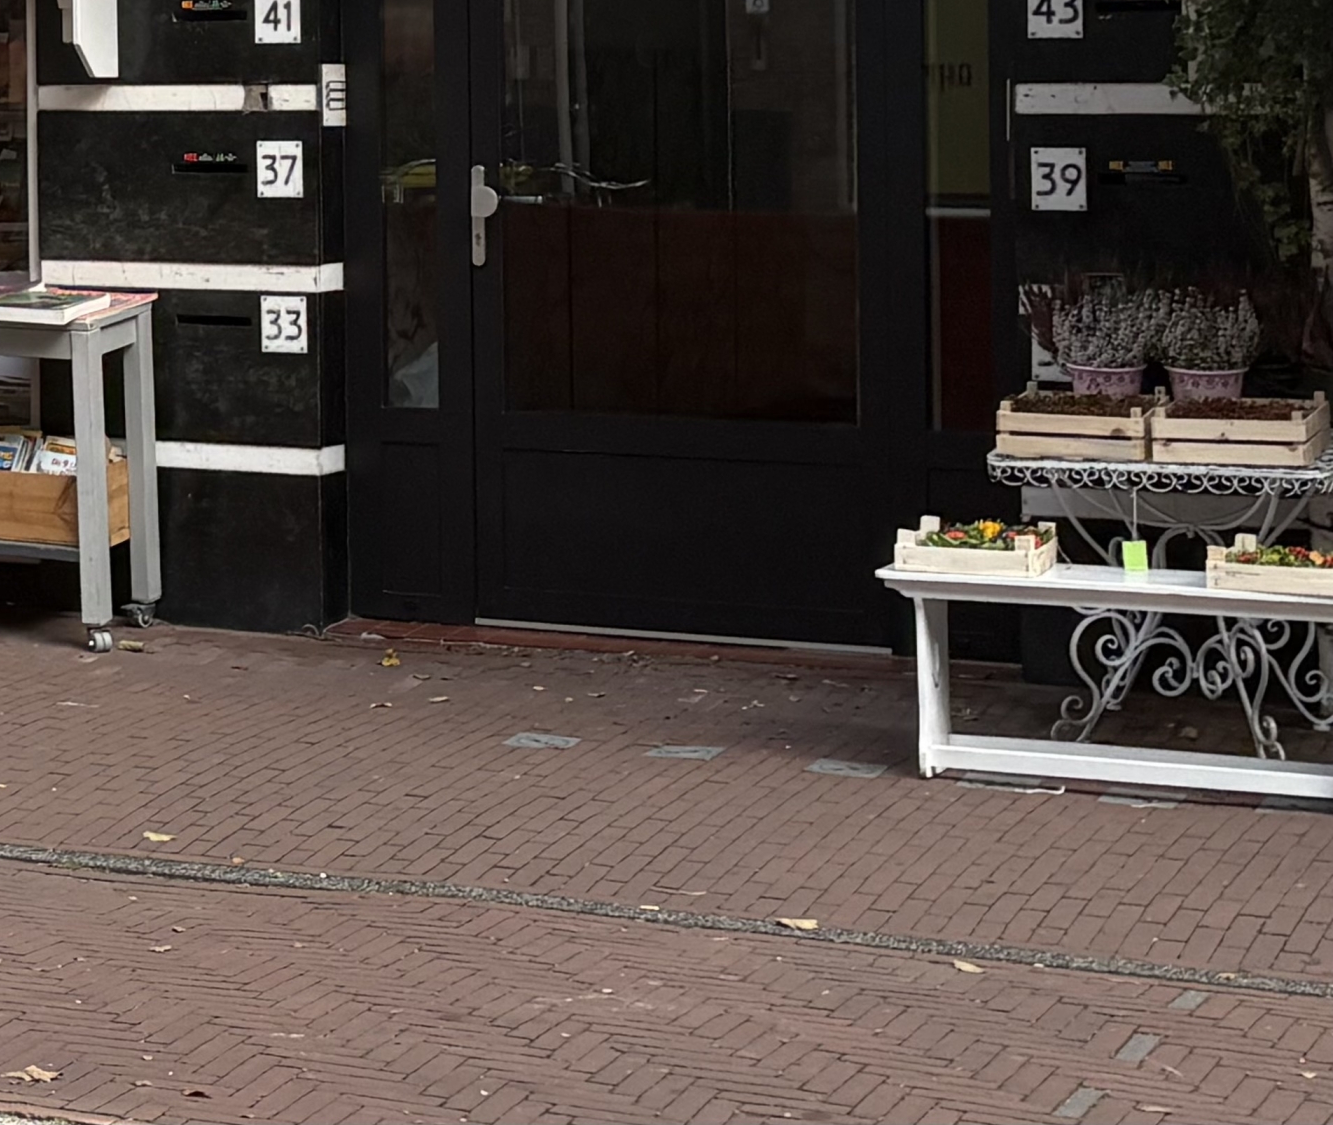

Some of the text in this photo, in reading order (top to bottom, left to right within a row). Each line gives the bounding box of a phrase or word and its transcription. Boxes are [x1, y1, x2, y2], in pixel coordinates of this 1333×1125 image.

[262, 0, 292, 32] 41
[261, 154, 298, 186] 37
[1036, 161, 1082, 197] 39
[265, 308, 303, 341] 33
